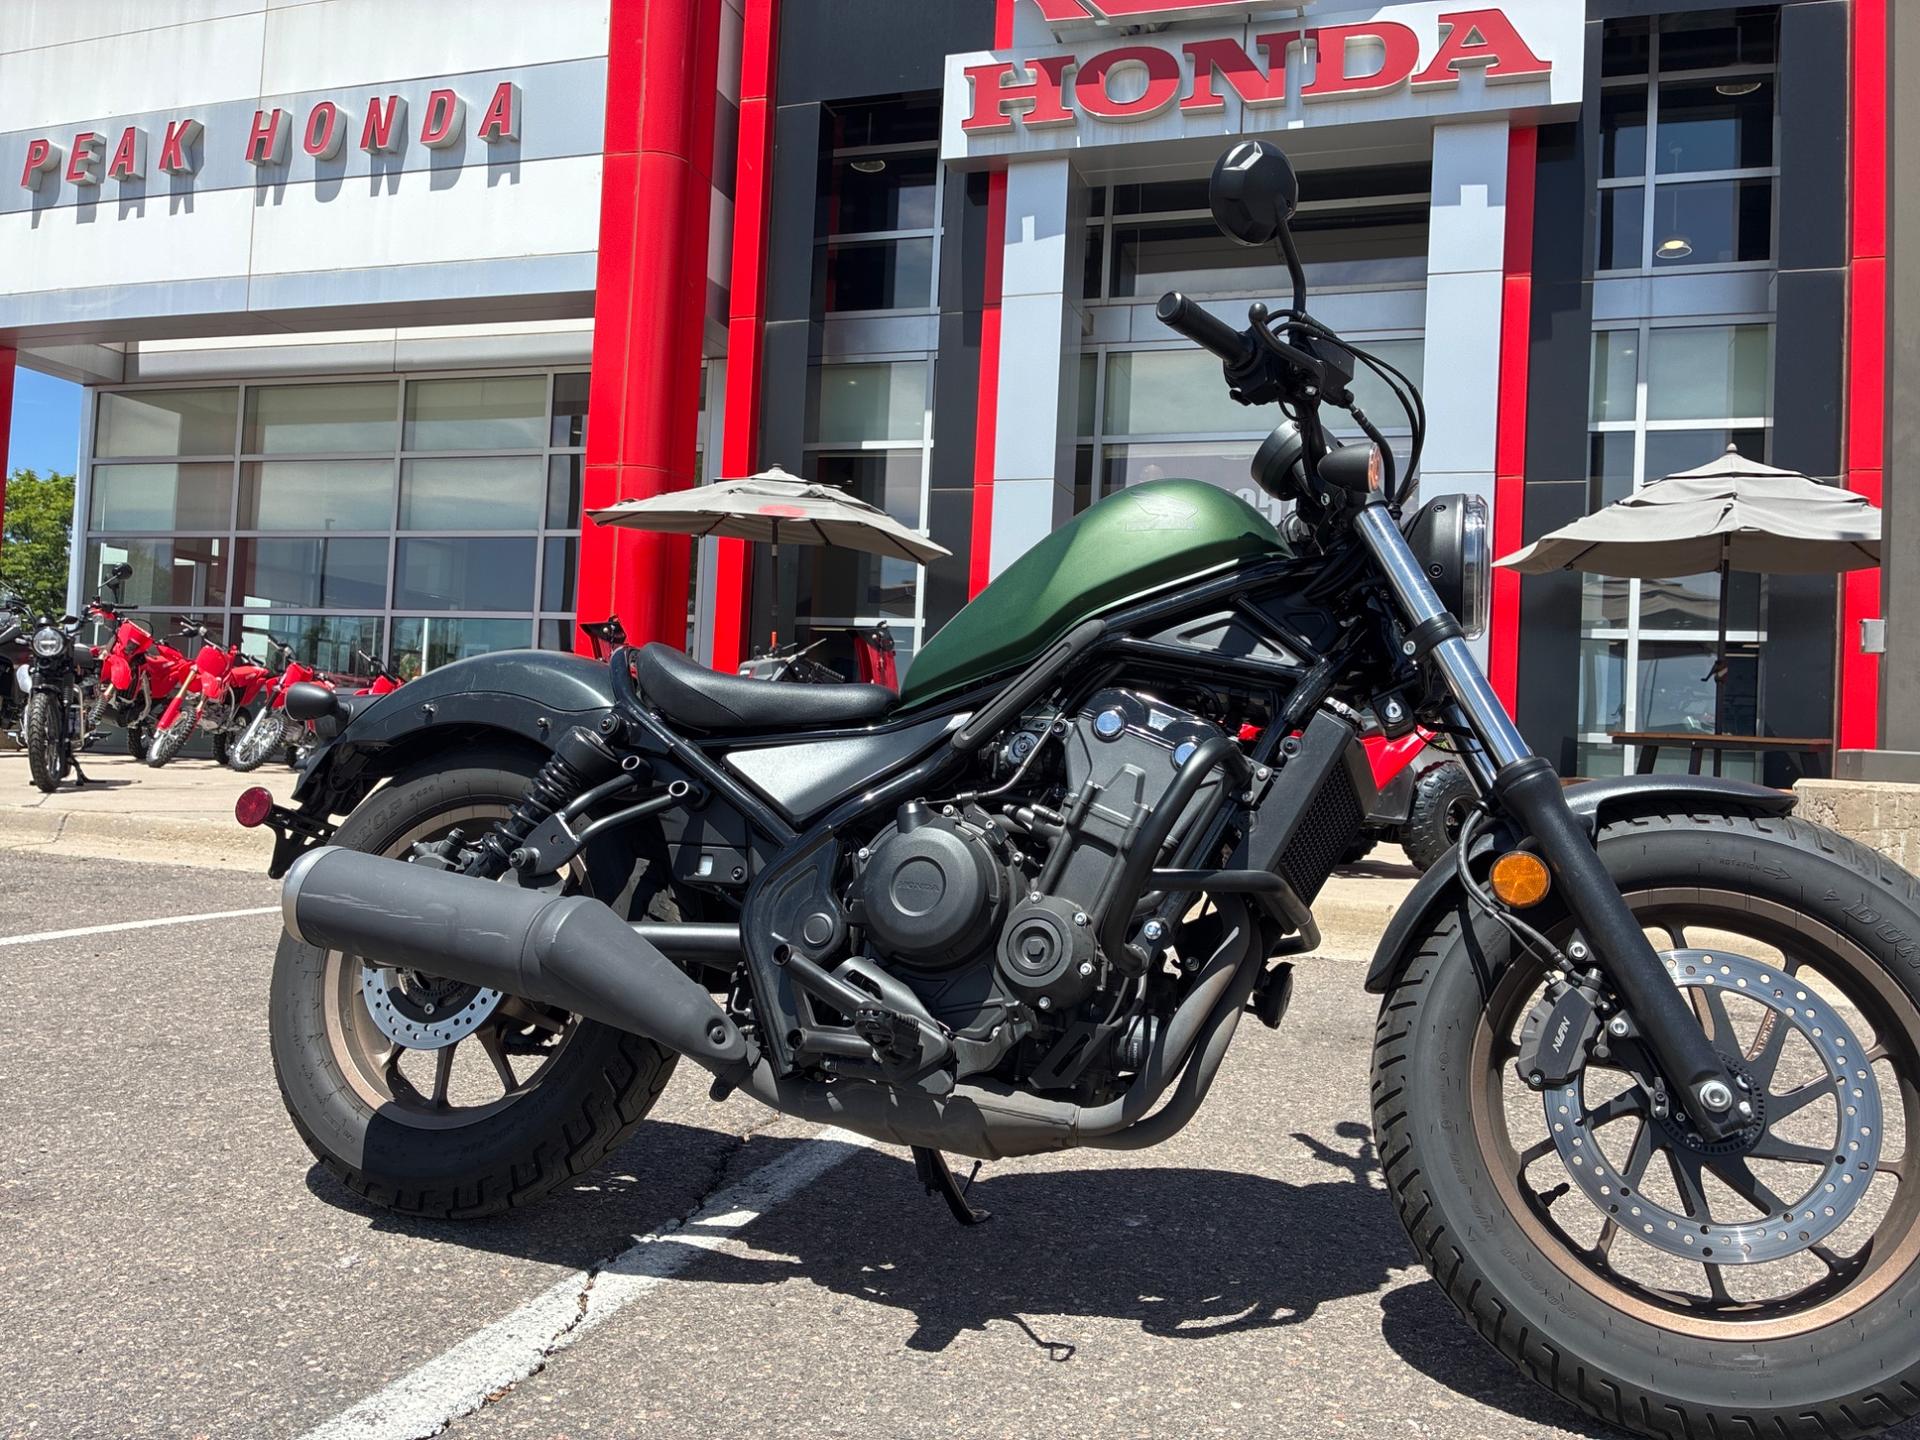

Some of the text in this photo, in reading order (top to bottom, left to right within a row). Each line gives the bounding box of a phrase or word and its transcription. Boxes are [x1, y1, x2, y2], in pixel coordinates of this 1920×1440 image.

[961, 8, 1552, 133] HONDA
[20, 81, 520, 191] PEAK HONDA
